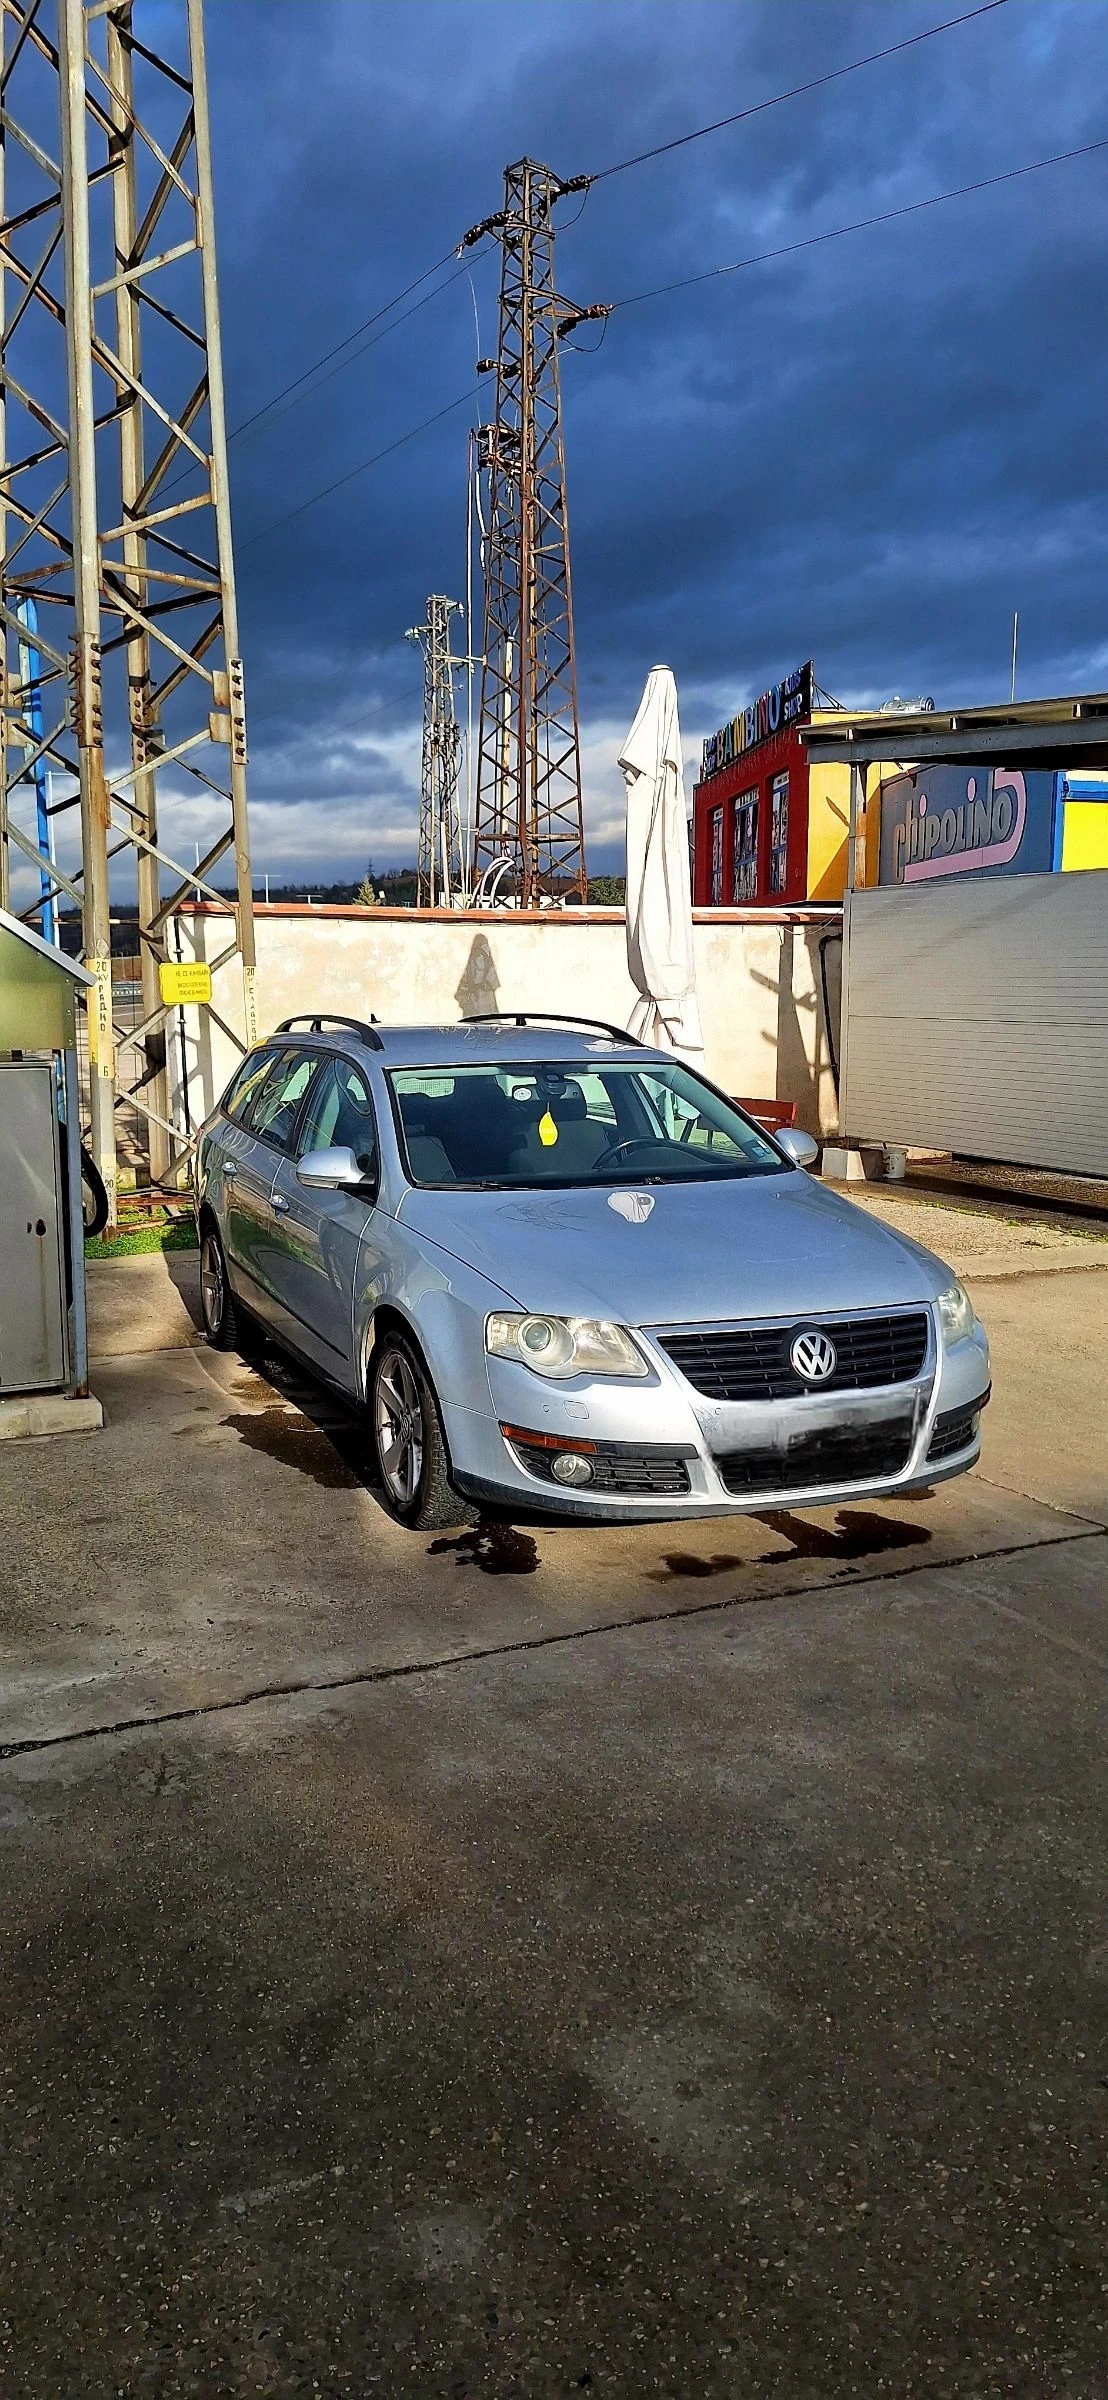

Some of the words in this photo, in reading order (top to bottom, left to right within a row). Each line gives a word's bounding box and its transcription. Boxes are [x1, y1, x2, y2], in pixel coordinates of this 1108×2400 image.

[716, 684, 780, 768] BAMBINO
[95, 961, 107, 973] 20
[246, 967, 255, 976] 20
